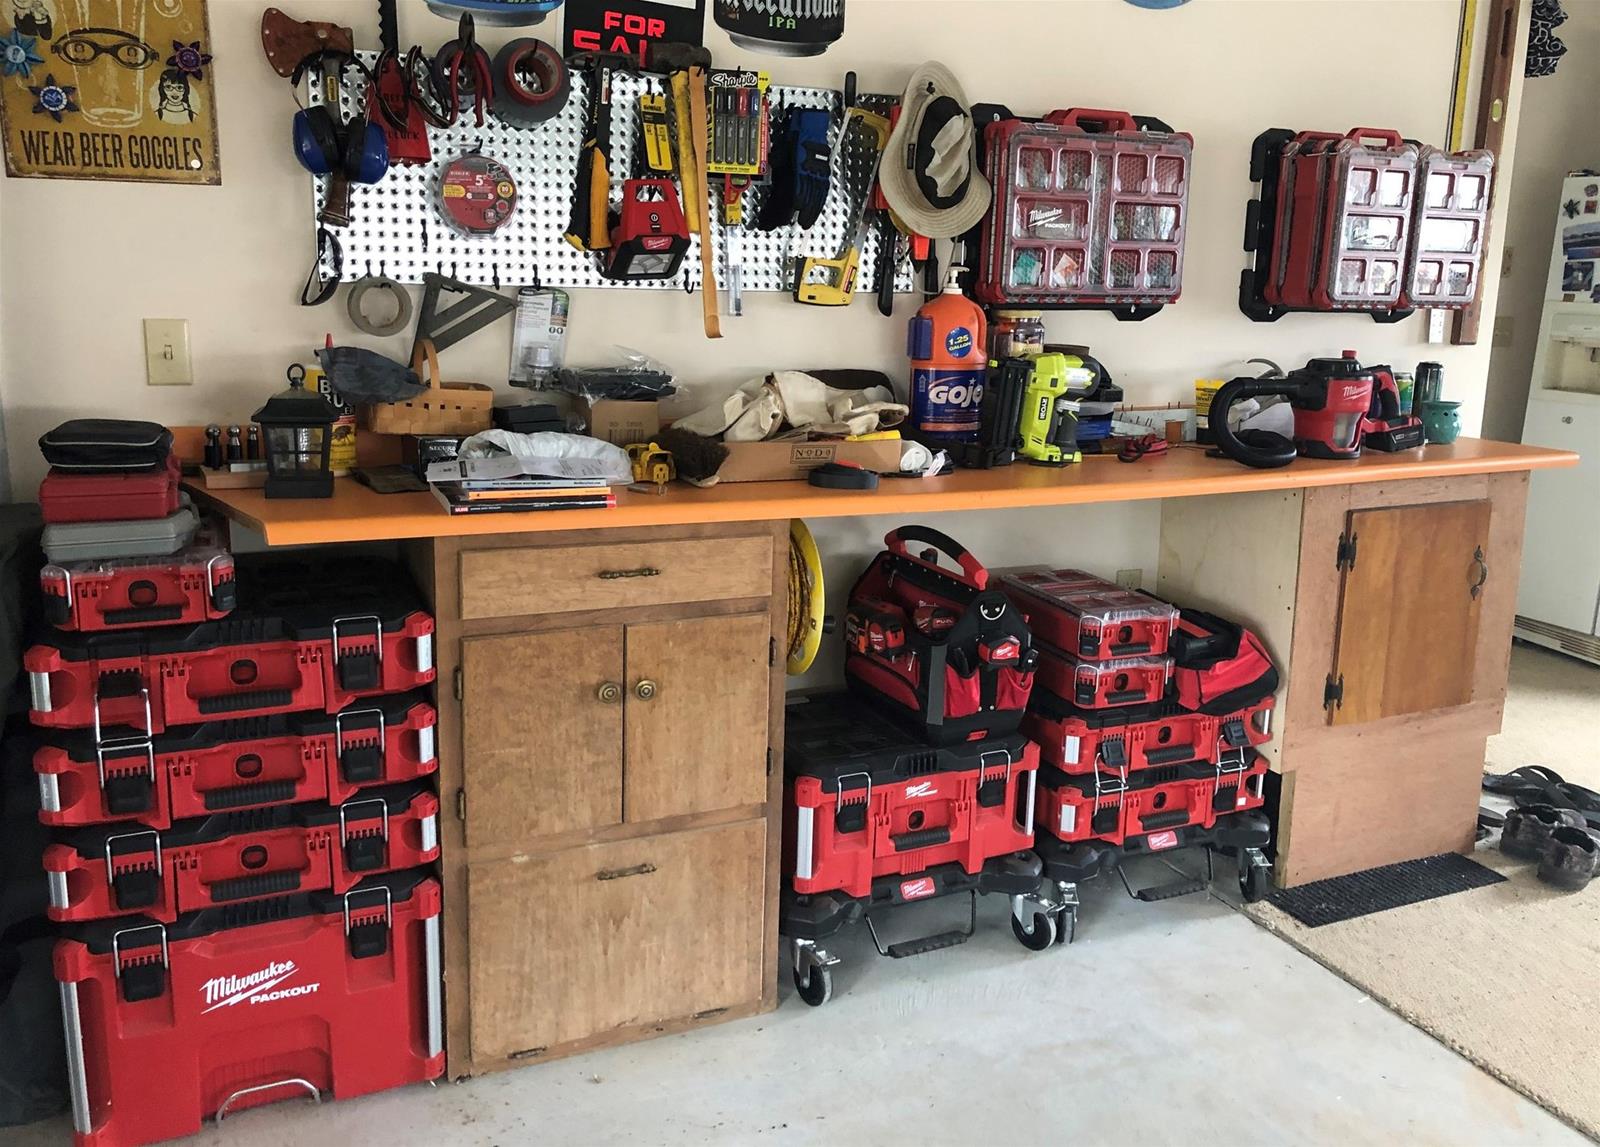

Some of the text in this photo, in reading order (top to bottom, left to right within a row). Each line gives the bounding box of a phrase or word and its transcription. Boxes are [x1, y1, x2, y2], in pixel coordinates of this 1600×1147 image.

[604, 10, 665, 38] FOR
[768, 16, 797, 30] IPA
[572, 29, 649, 68] SAL
[711, 71, 757, 89] Sharpie
[20, 130, 204, 172] WEAR BEER GOGGLES
[948, 333, 969, 346] 1.25
[948, 341, 972, 353] GALLON
[198, 959, 296, 1004] Milwaukee
[250, 982, 321, 1005] PACKOUT
